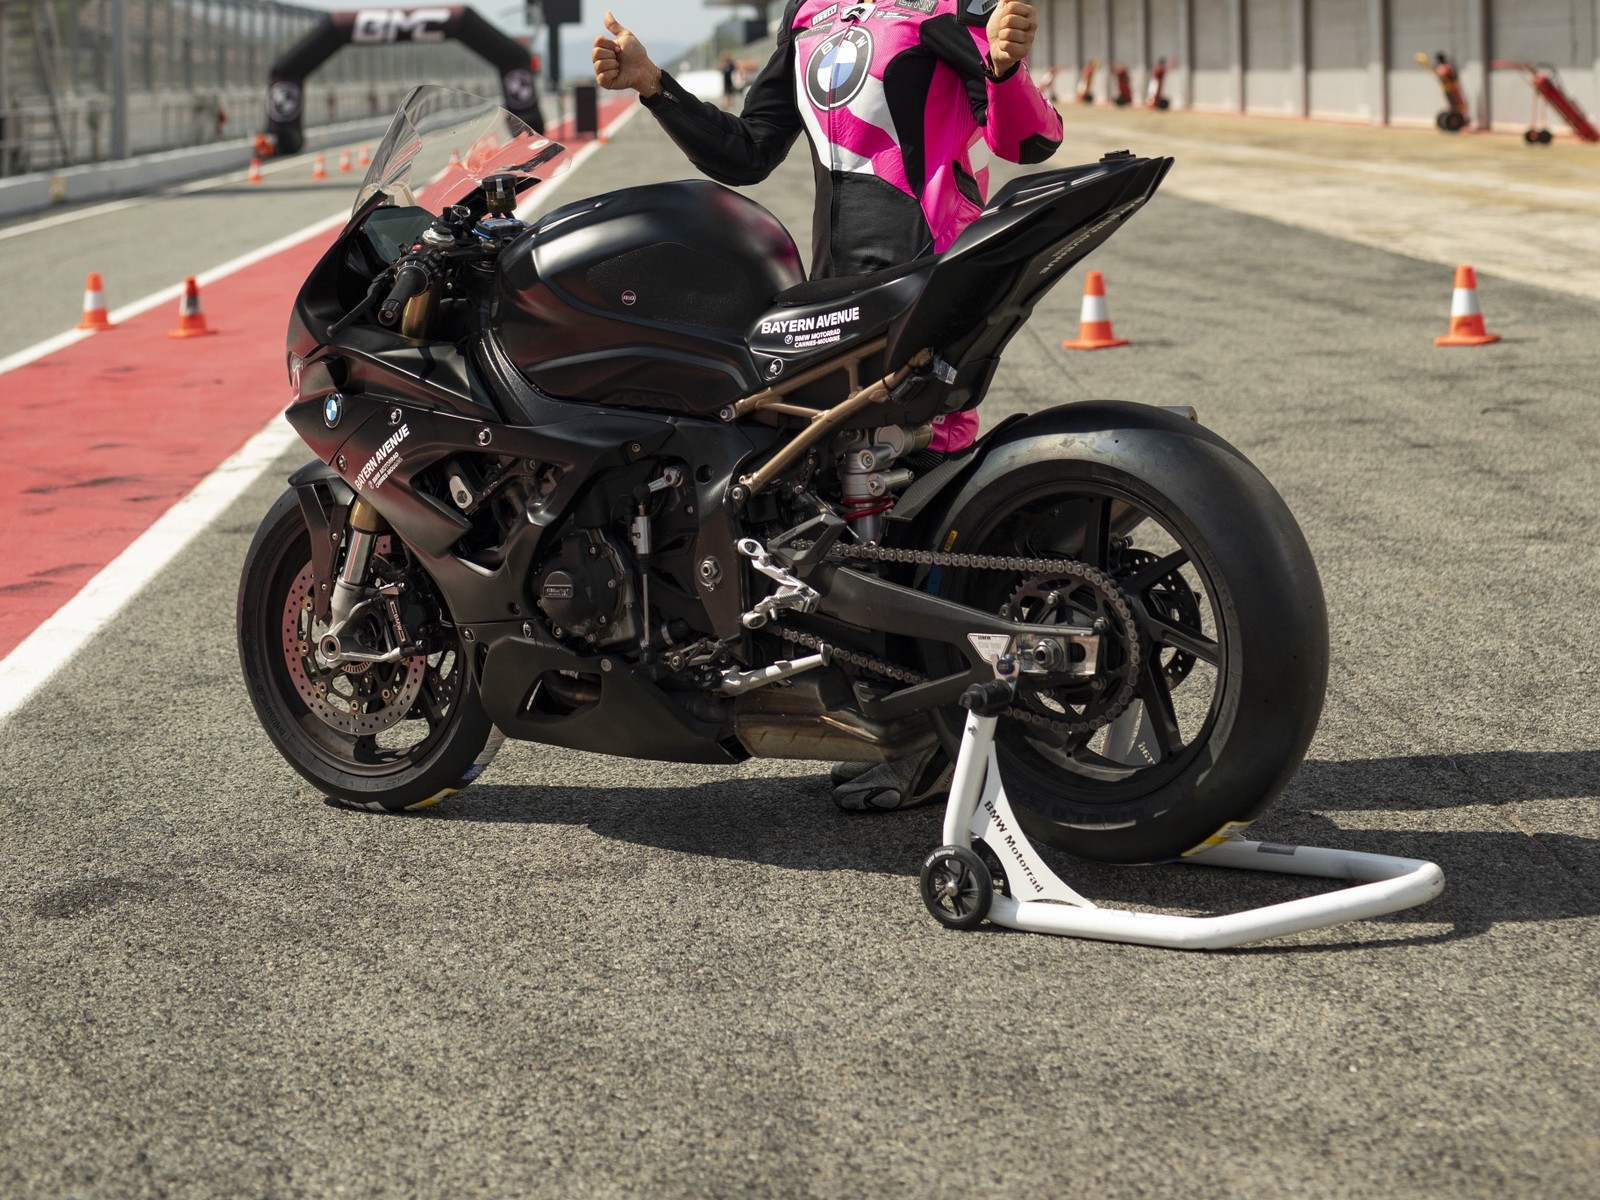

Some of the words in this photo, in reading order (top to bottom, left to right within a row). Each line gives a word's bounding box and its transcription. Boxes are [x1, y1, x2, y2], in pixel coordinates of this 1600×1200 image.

[761, 317, 815, 334] BAYERN
[816, 306, 860, 328] AVENUE
[354, 456, 378, 491] BAYERN
[375, 423, 411, 464] AVENUE
[984, 800, 1008, 833] BMW
[1004, 834, 1045, 893] Motorrad
